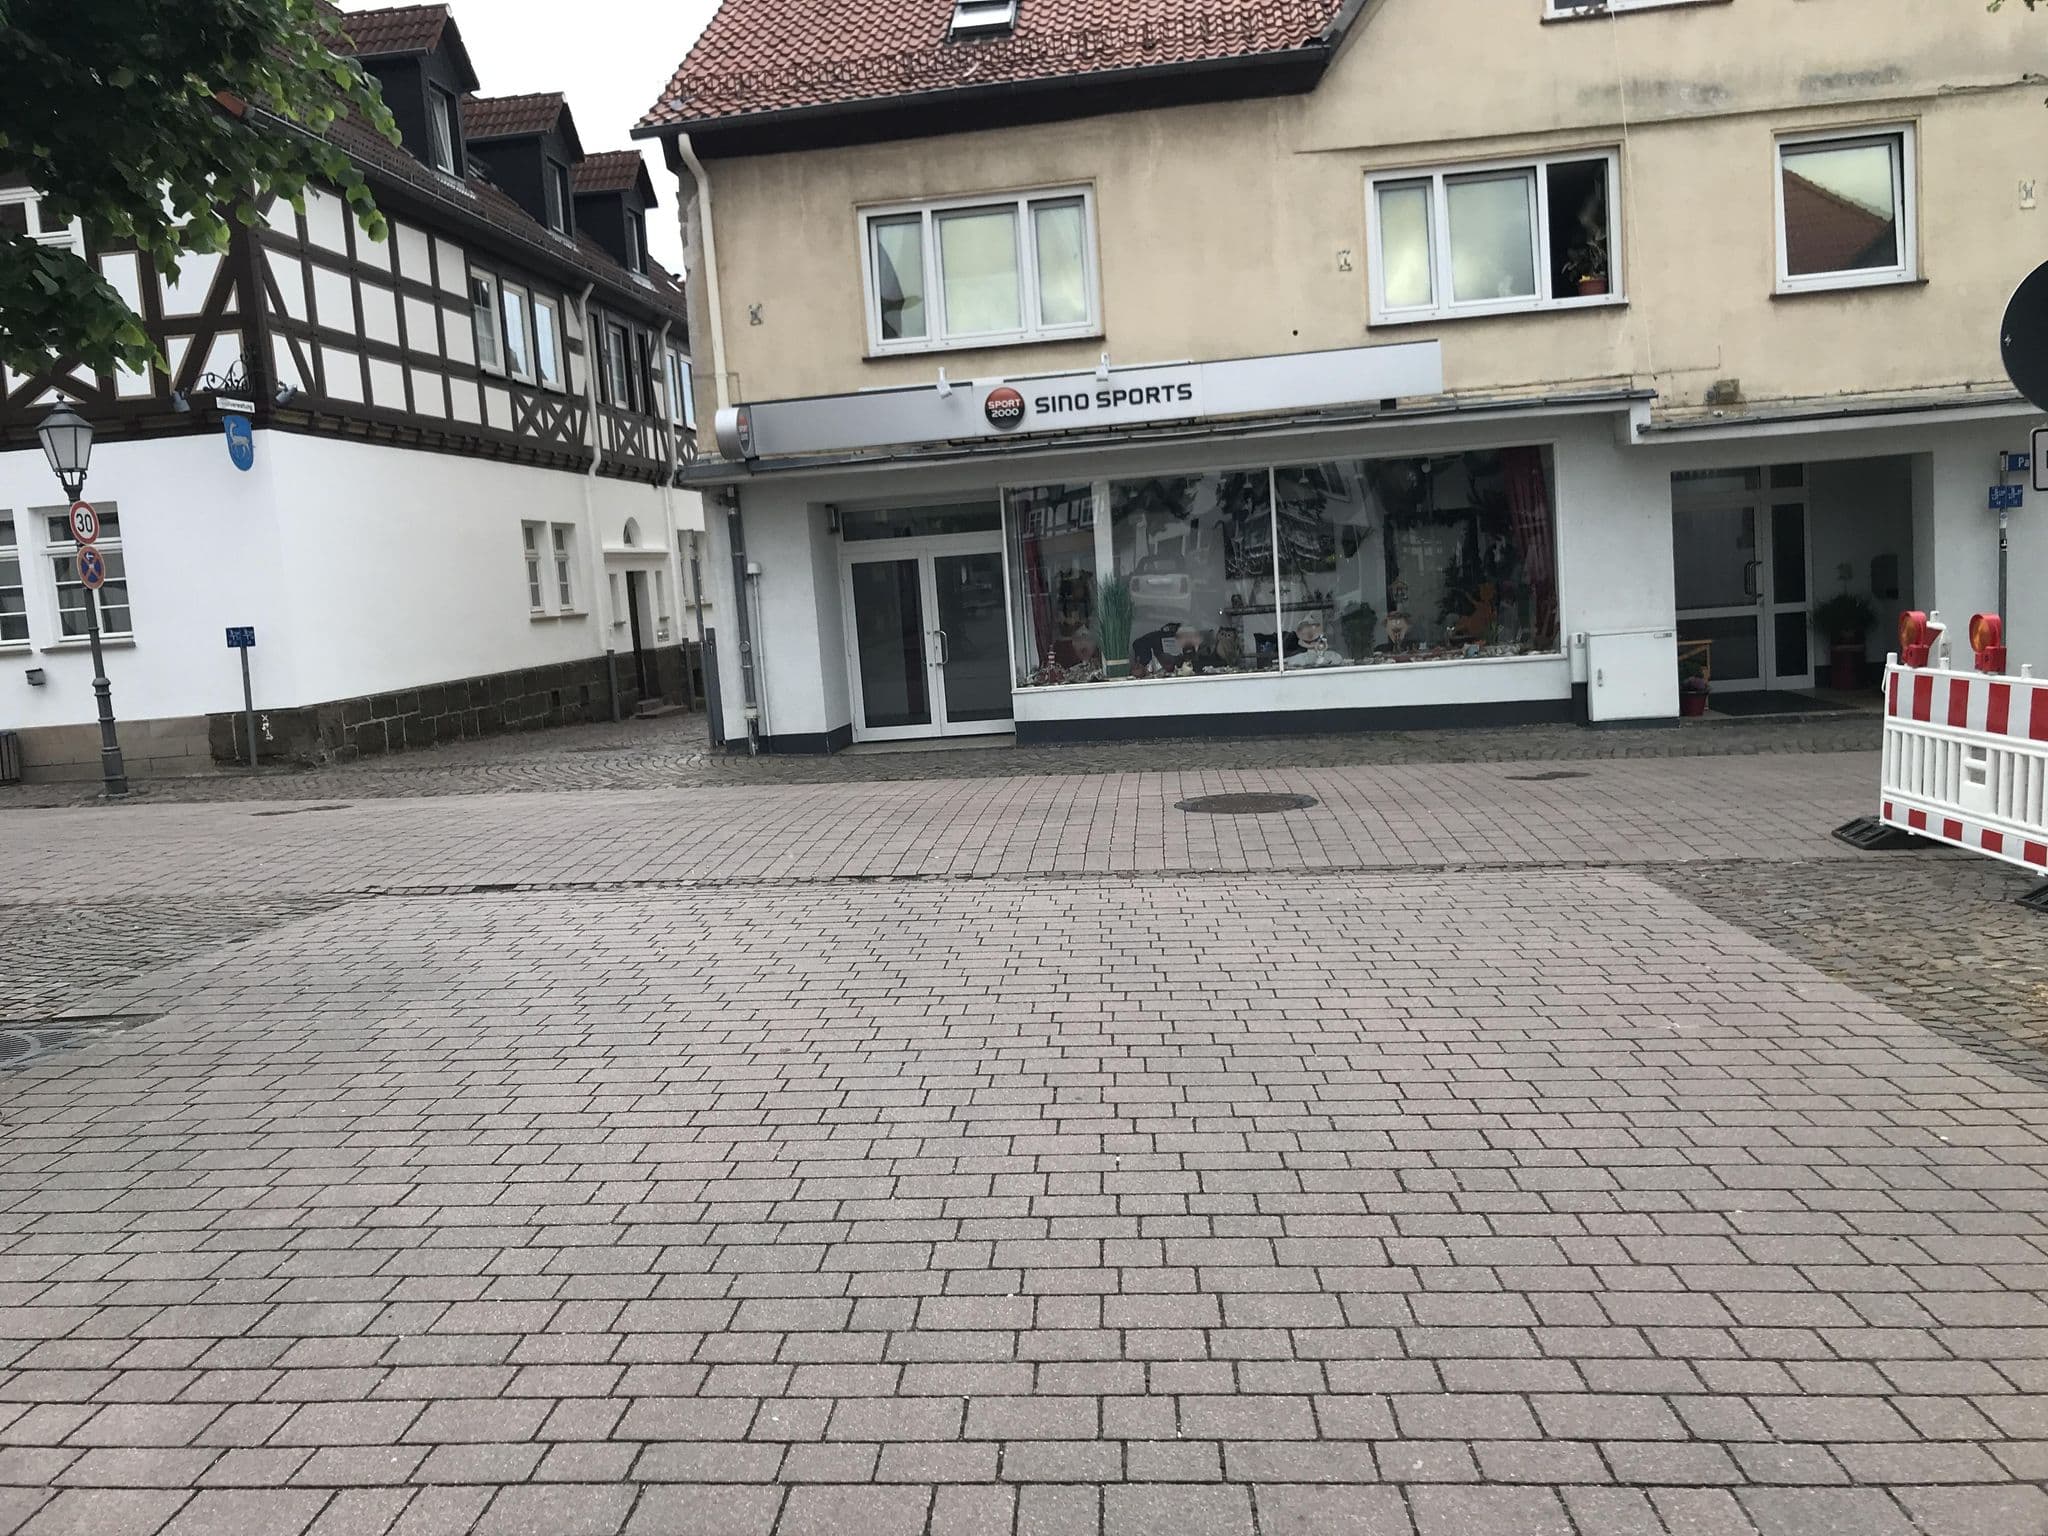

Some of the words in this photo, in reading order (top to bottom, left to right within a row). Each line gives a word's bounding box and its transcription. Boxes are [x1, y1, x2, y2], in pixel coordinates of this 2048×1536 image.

[987, 399, 1021, 410] SPORT
[1035, 393, 1090, 414] SINO
[1096, 383, 1193, 409] SPORTS
[991, 408, 1020, 418] 2000
[76, 513, 93, 533] 30
